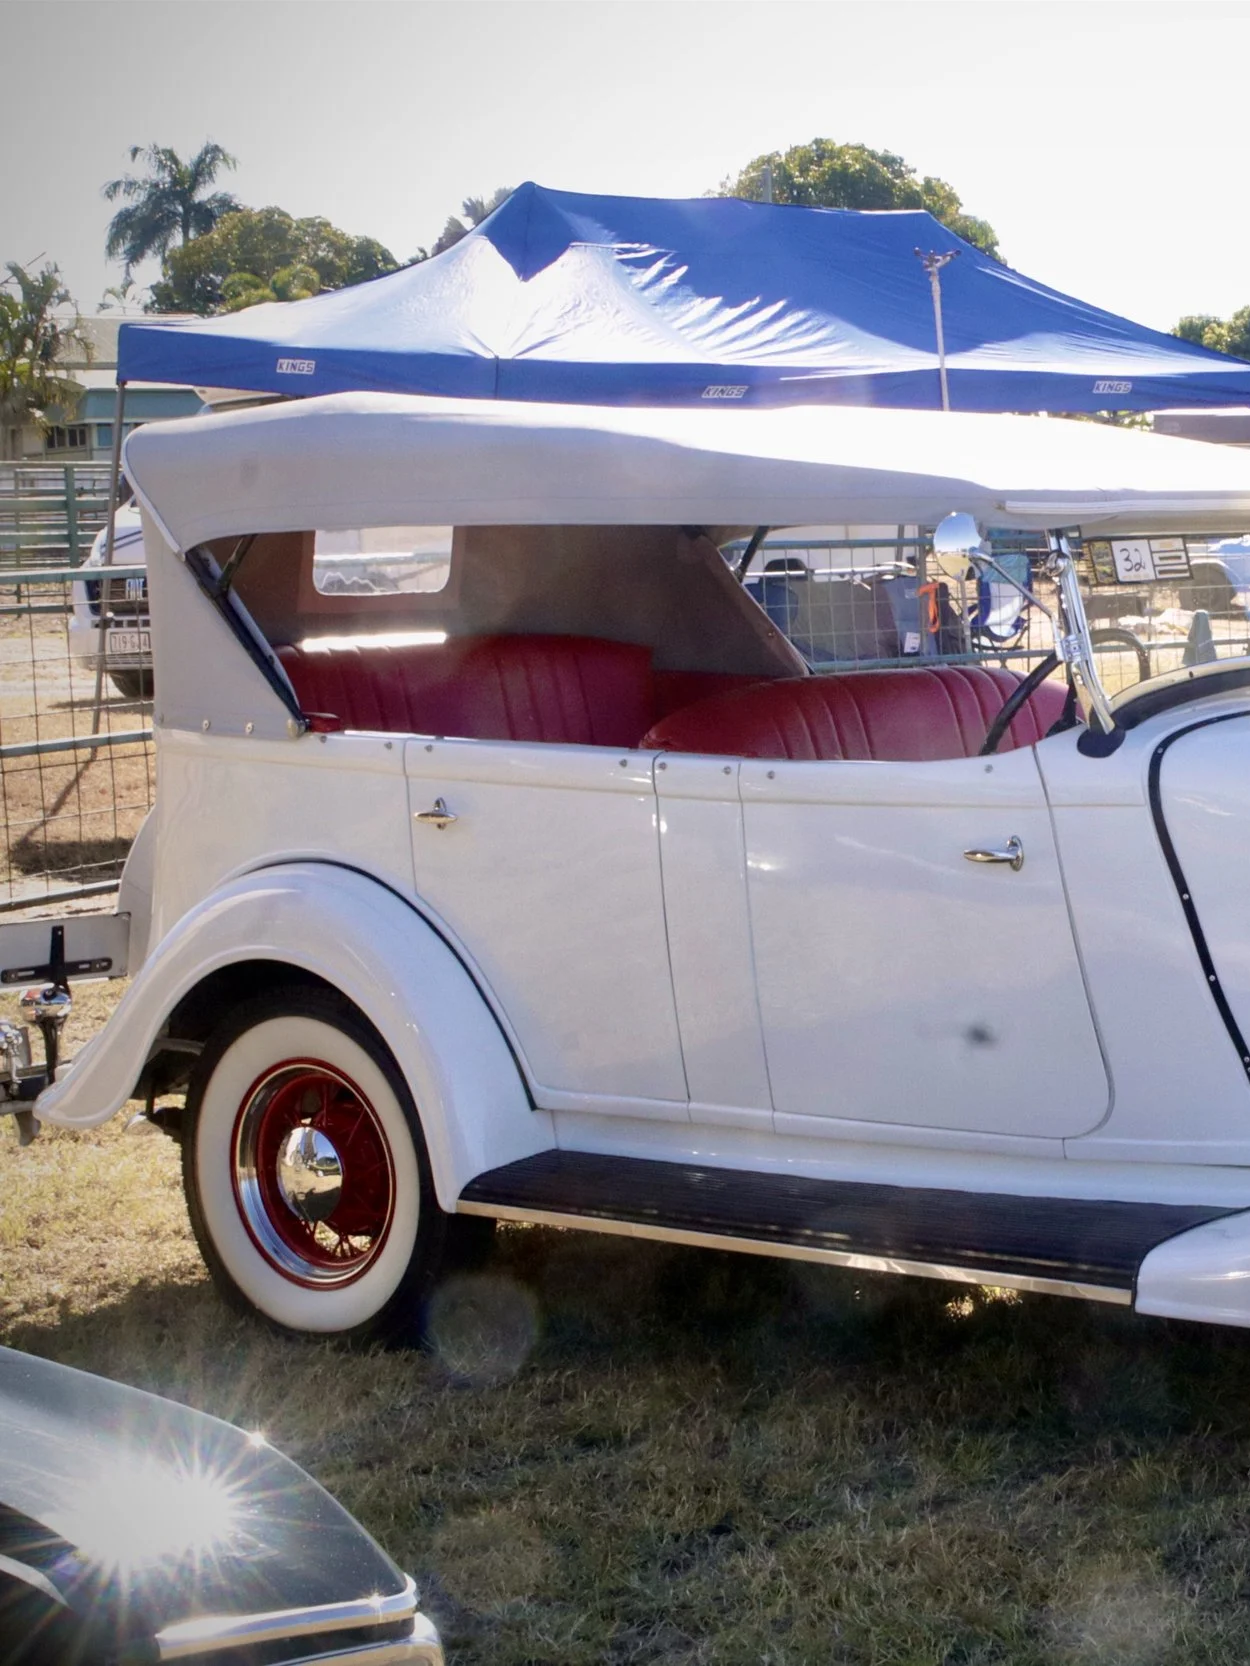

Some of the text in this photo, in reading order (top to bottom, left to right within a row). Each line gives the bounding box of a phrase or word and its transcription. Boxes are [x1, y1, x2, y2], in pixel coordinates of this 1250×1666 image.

[277, 359, 315, 374] KINGS
[702, 386, 748, 398] KINGS
[1093, 381, 1131, 393] KINGS
[1119, 547, 1146, 572] 32
